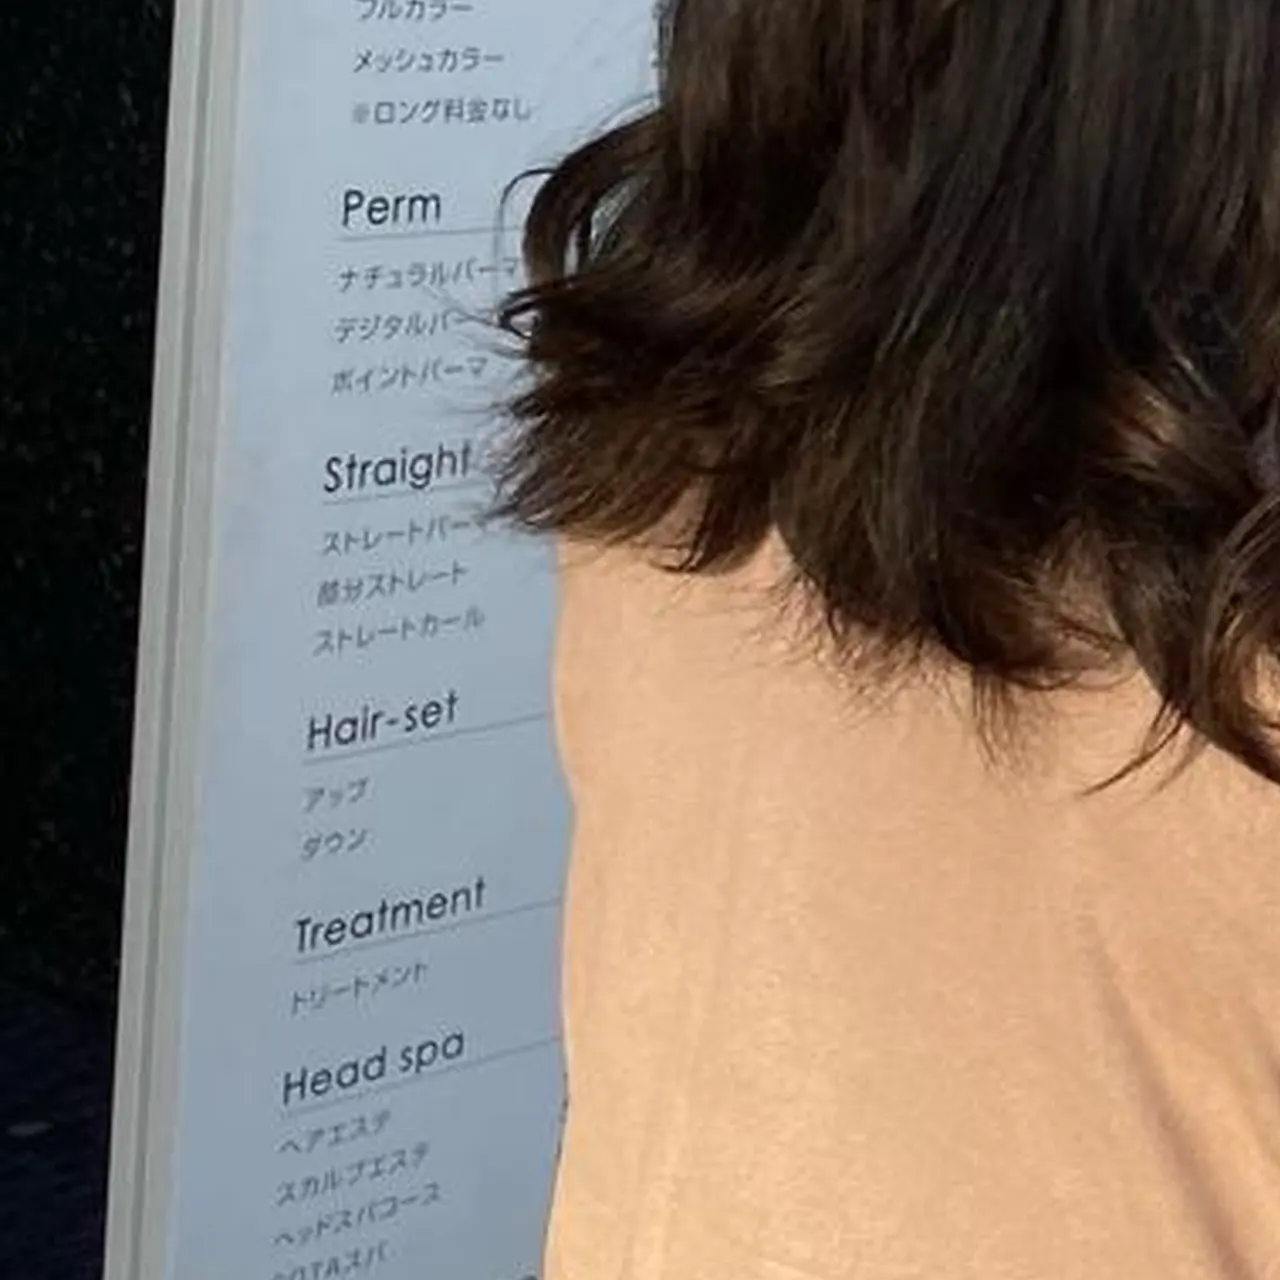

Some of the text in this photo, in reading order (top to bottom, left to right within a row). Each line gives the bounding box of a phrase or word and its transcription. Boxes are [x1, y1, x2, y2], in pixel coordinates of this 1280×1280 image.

[352, 45, 505, 74] メッシュカラー
[340, 189, 443, 227] Perm
[322, 442, 474, 494] Straight
[306, 688, 459, 752] Hair-set
[296, 876, 486, 953] Treatment
[291, 963, 428, 1016] トリートメント
[283, 1032, 465, 1107] Head spa
